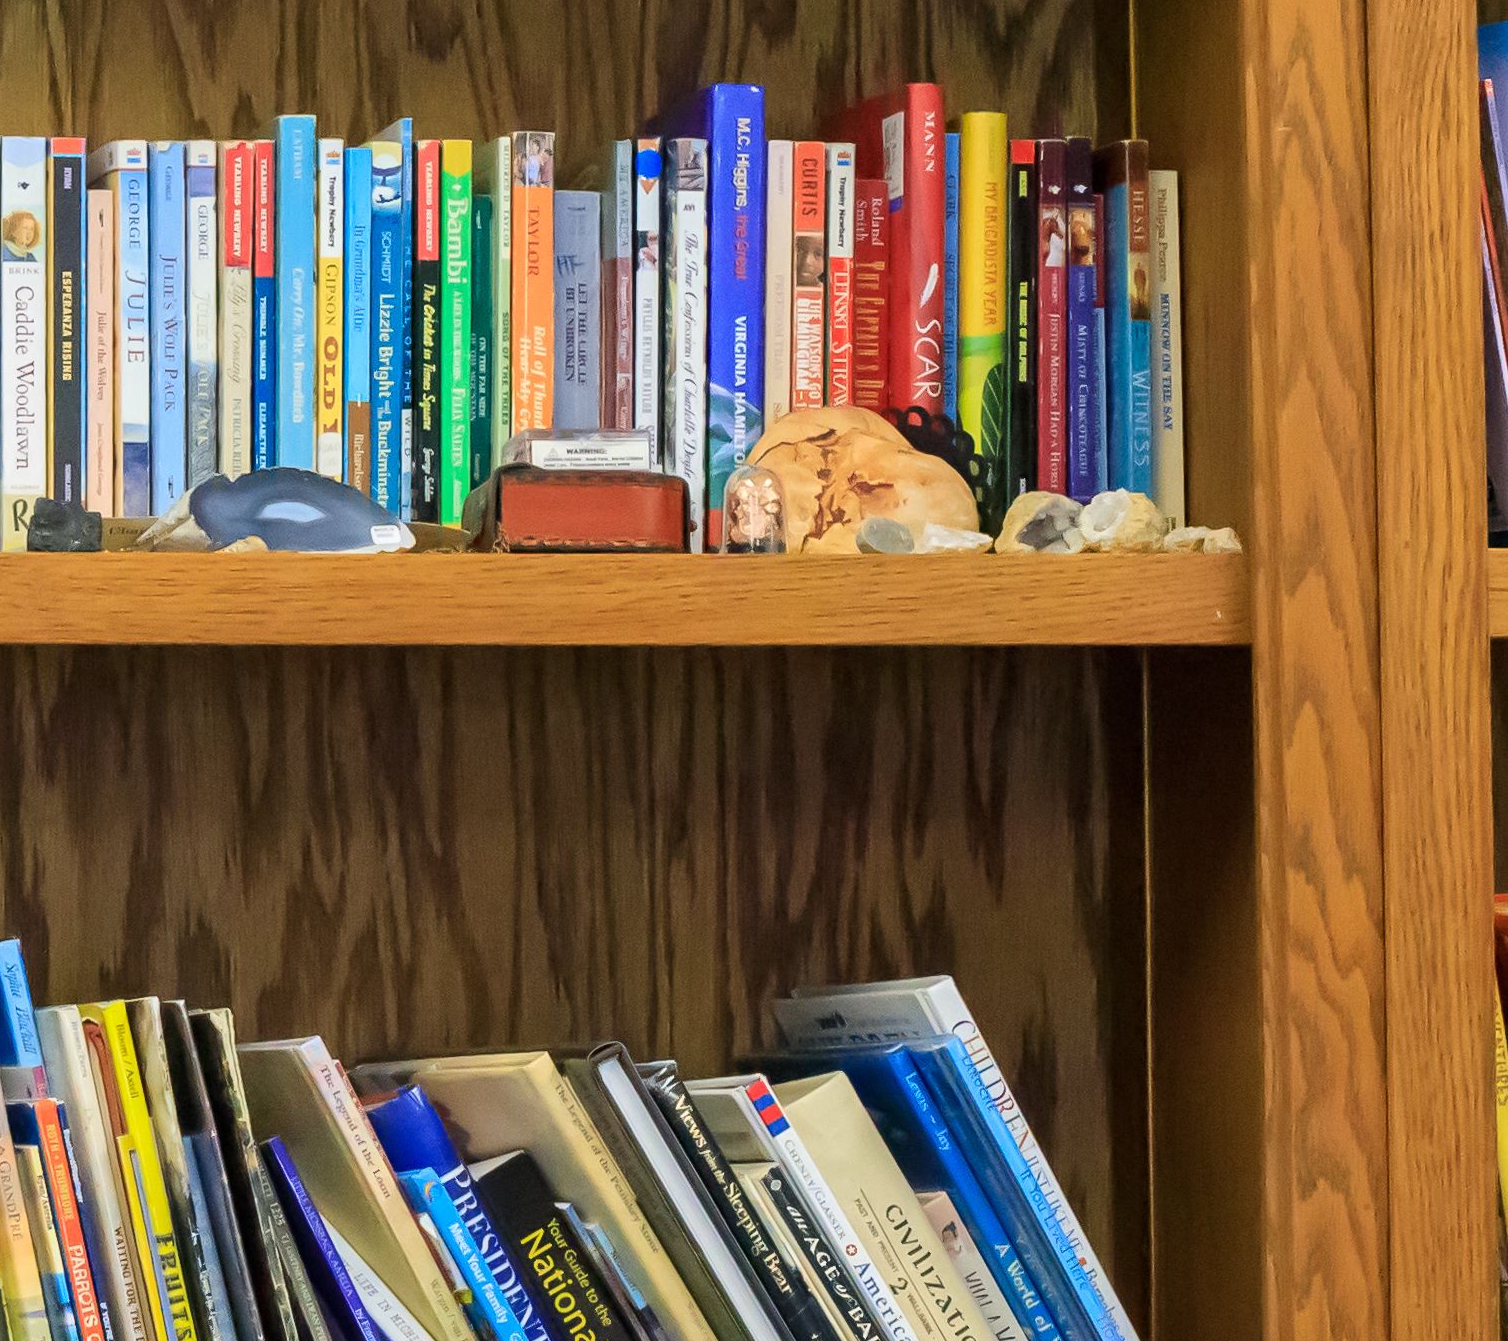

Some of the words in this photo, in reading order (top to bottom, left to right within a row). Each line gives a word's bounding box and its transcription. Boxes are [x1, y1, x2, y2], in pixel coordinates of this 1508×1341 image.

[446, 197, 468, 284] Bambi
[14, 285, 34, 355] Caddie
[61, 271, 73, 336] ESPERANZA
[62, 341, 73, 381] RISING
[913, 319, 942, 400] SCAR
[15, 361, 34, 471] Woodlawn
[1131, 369, 1150, 467] WITNESS
[68, 1244, 97, 1328] PARROTS
[803, 1233, 840, 1283] AGE
